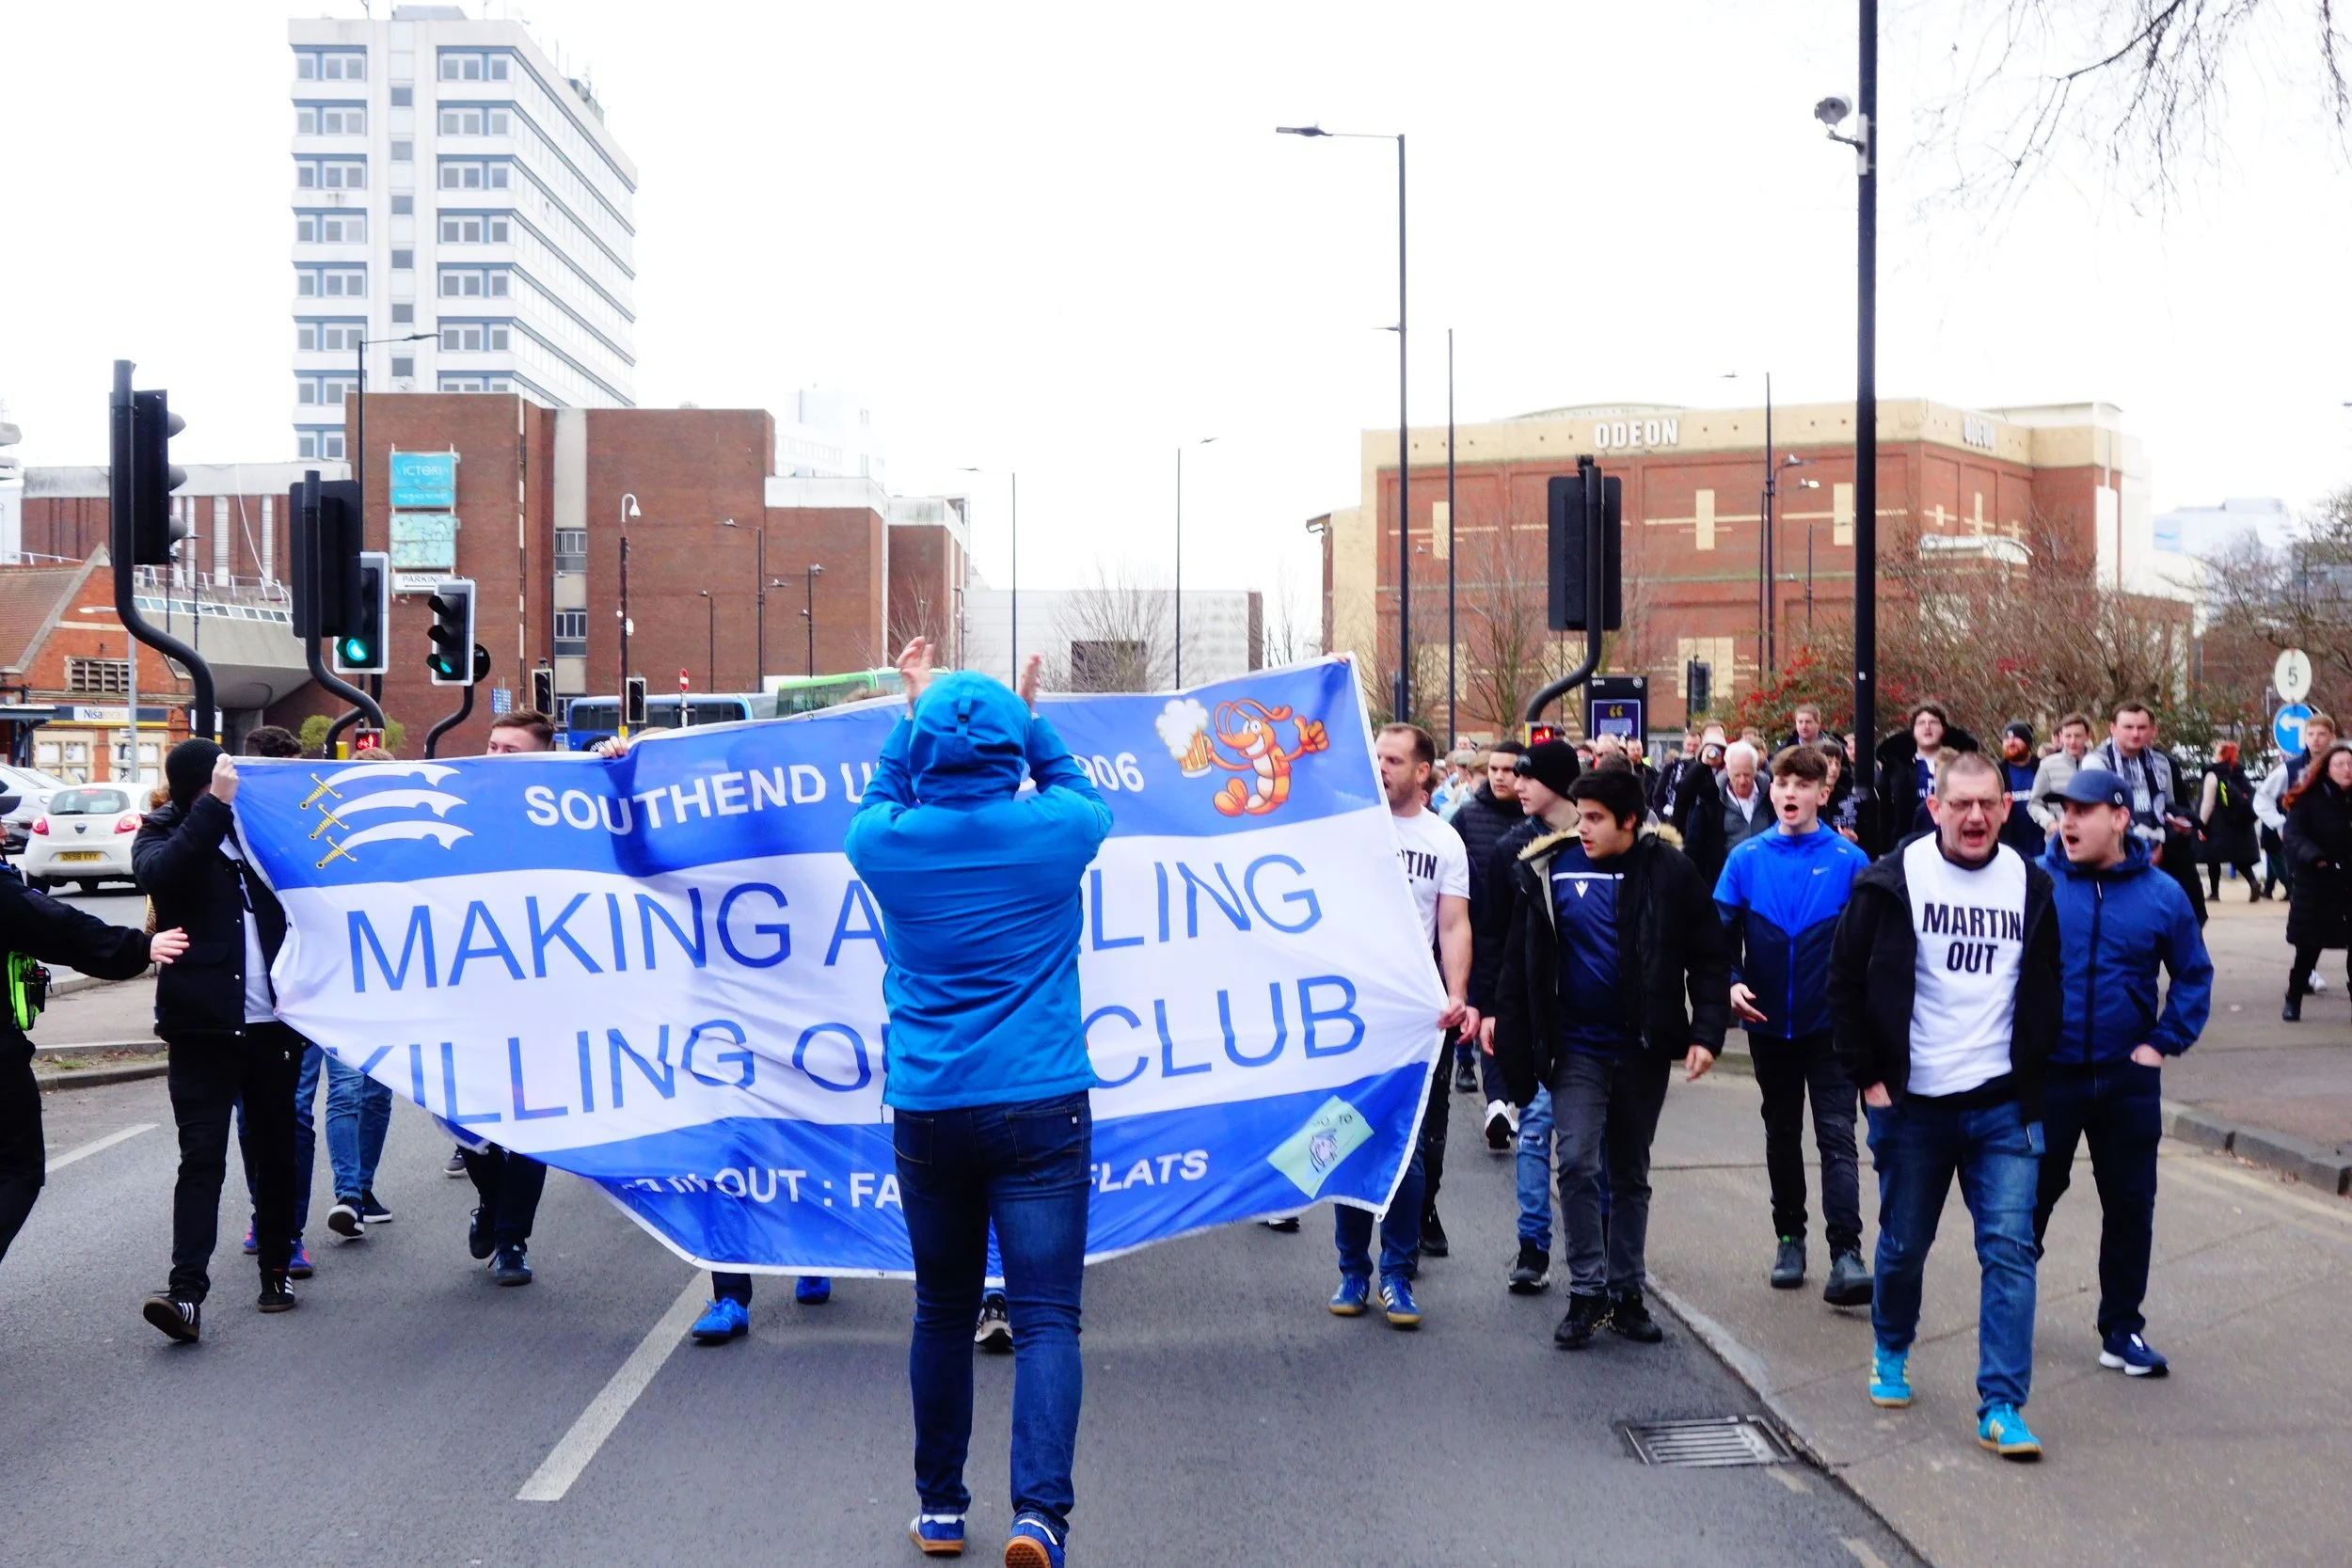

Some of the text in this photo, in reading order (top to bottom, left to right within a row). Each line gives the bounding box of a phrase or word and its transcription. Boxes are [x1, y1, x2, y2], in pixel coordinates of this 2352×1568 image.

[1595, 419, 1678, 450] ODEON
[2288, 666, 2298, 687] 5
[524, 763, 827, 836] SOUTHEND
[1401, 849, 1438, 880] TIN
[346, 854, 1323, 993] MAKING A LING
[1922, 902, 2022, 942] MARTIN
[1947, 942, 1998, 975] OUT
[1082, 974, 1366, 1089] CLUB
[713, 1165, 807, 1204] OUT
